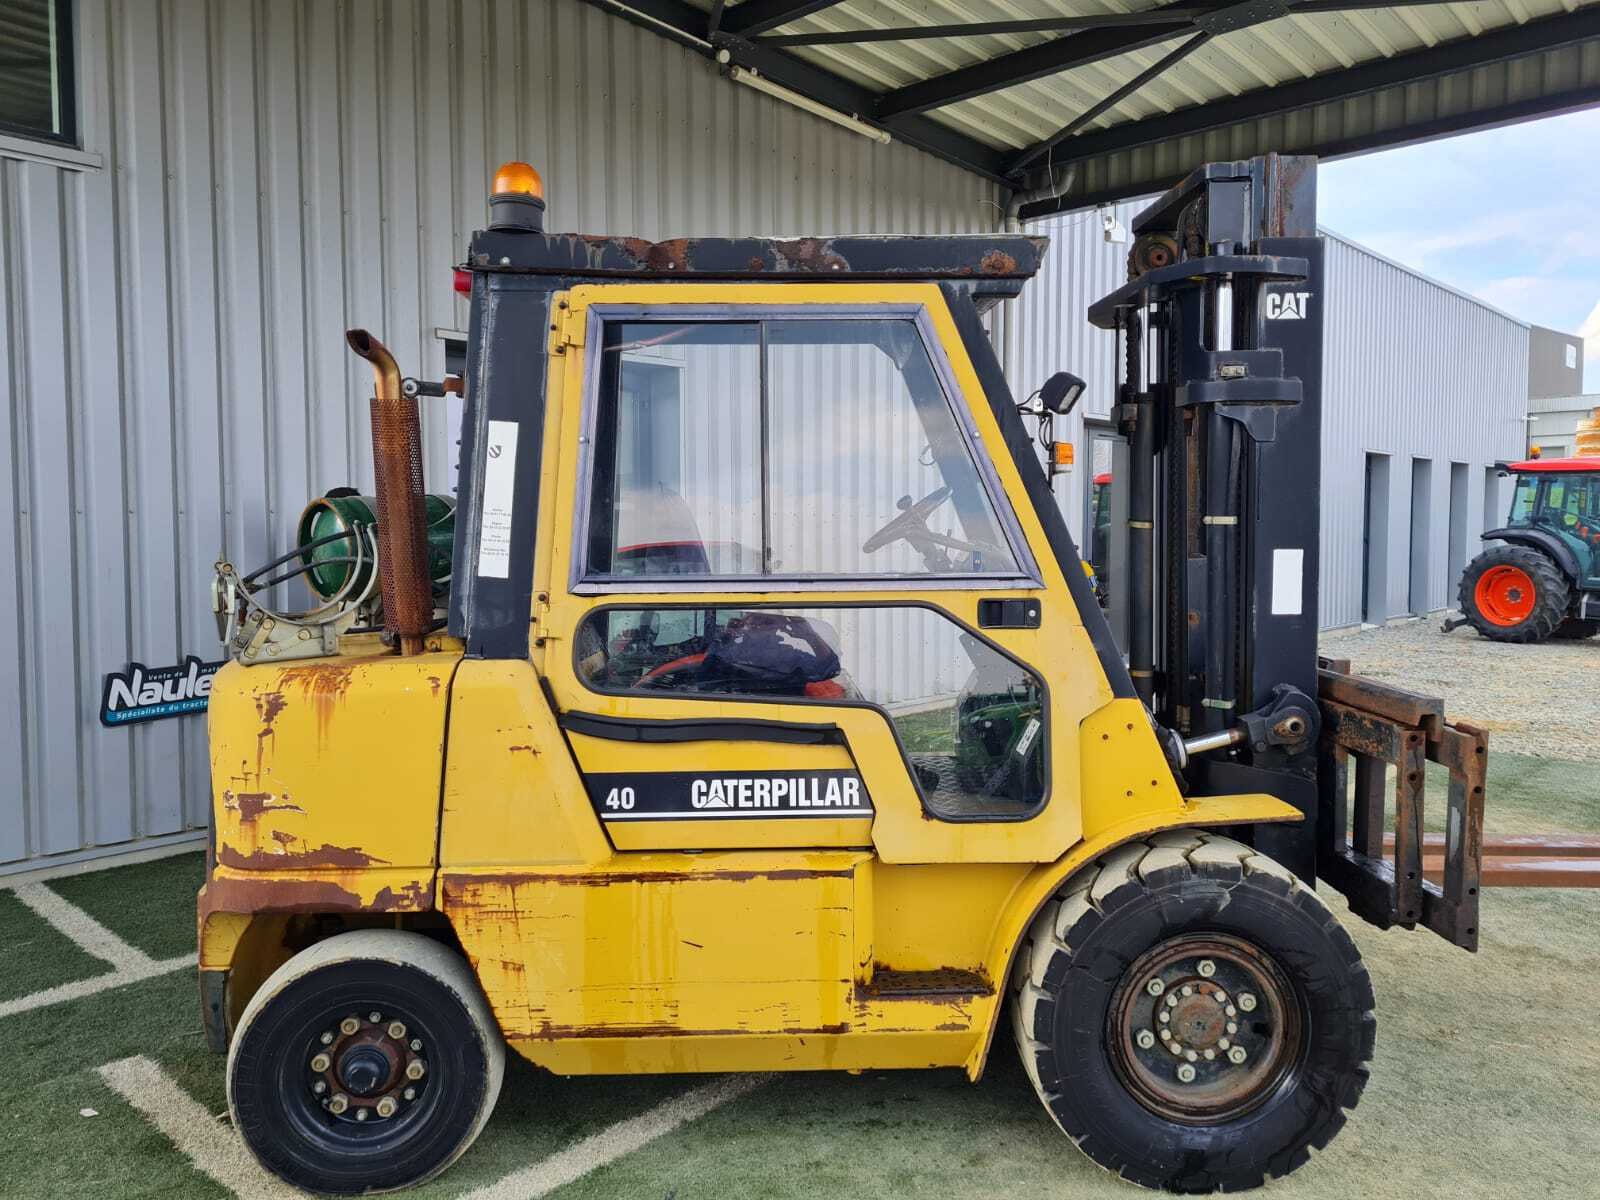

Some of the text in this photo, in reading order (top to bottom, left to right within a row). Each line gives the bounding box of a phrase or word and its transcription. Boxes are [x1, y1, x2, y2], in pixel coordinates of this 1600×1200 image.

[1267, 292, 1306, 319] CAT
[116, 706, 165, 720] Spécialiste
[605, 778, 860, 809] 40 CATERPILLAR
